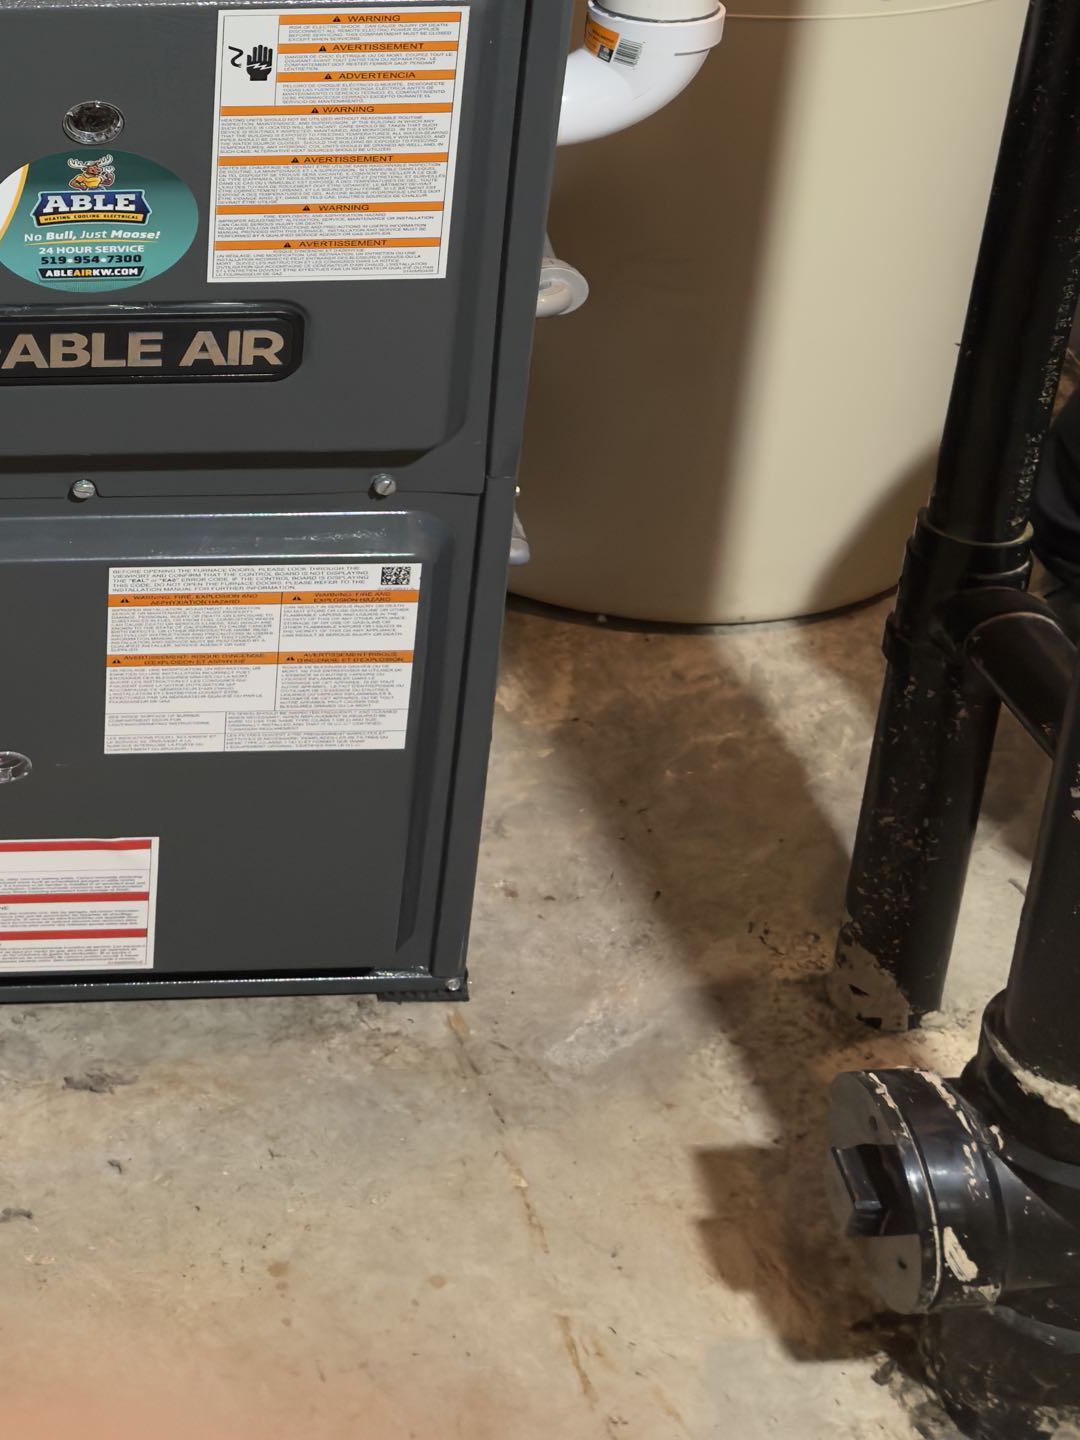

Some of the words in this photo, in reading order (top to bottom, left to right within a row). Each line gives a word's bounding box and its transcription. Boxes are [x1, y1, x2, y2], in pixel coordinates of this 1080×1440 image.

[347, 14, 401, 22] WARNING
[332, 42, 425, 52] AVERTISSEMENT
[338, 72, 416, 80] ADVERTENCIA
[322, 106, 375, 114] WARNING
[304, 155, 394, 164] AVERTISSEMENT
[42, 193, 136, 214] ABLE
[318, 204, 370, 212] WARNING
[24, 233, 42, 242] No
[46, 230, 77, 241] Bull,
[80, 230, 108, 240] Just
[110, 229, 161, 240] Moose!
[298, 240, 388, 248] AVERTISSEMENT
[39, 247, 54, 255] 24
[56, 246, 92, 254] HOUR
[94, 245, 145, 253] SERVICE
[45, 267, 138, 277] ABLEAIRKW.COM
[1, 331, 164, 370] ABLE
[178, 329, 284, 367] AIR
